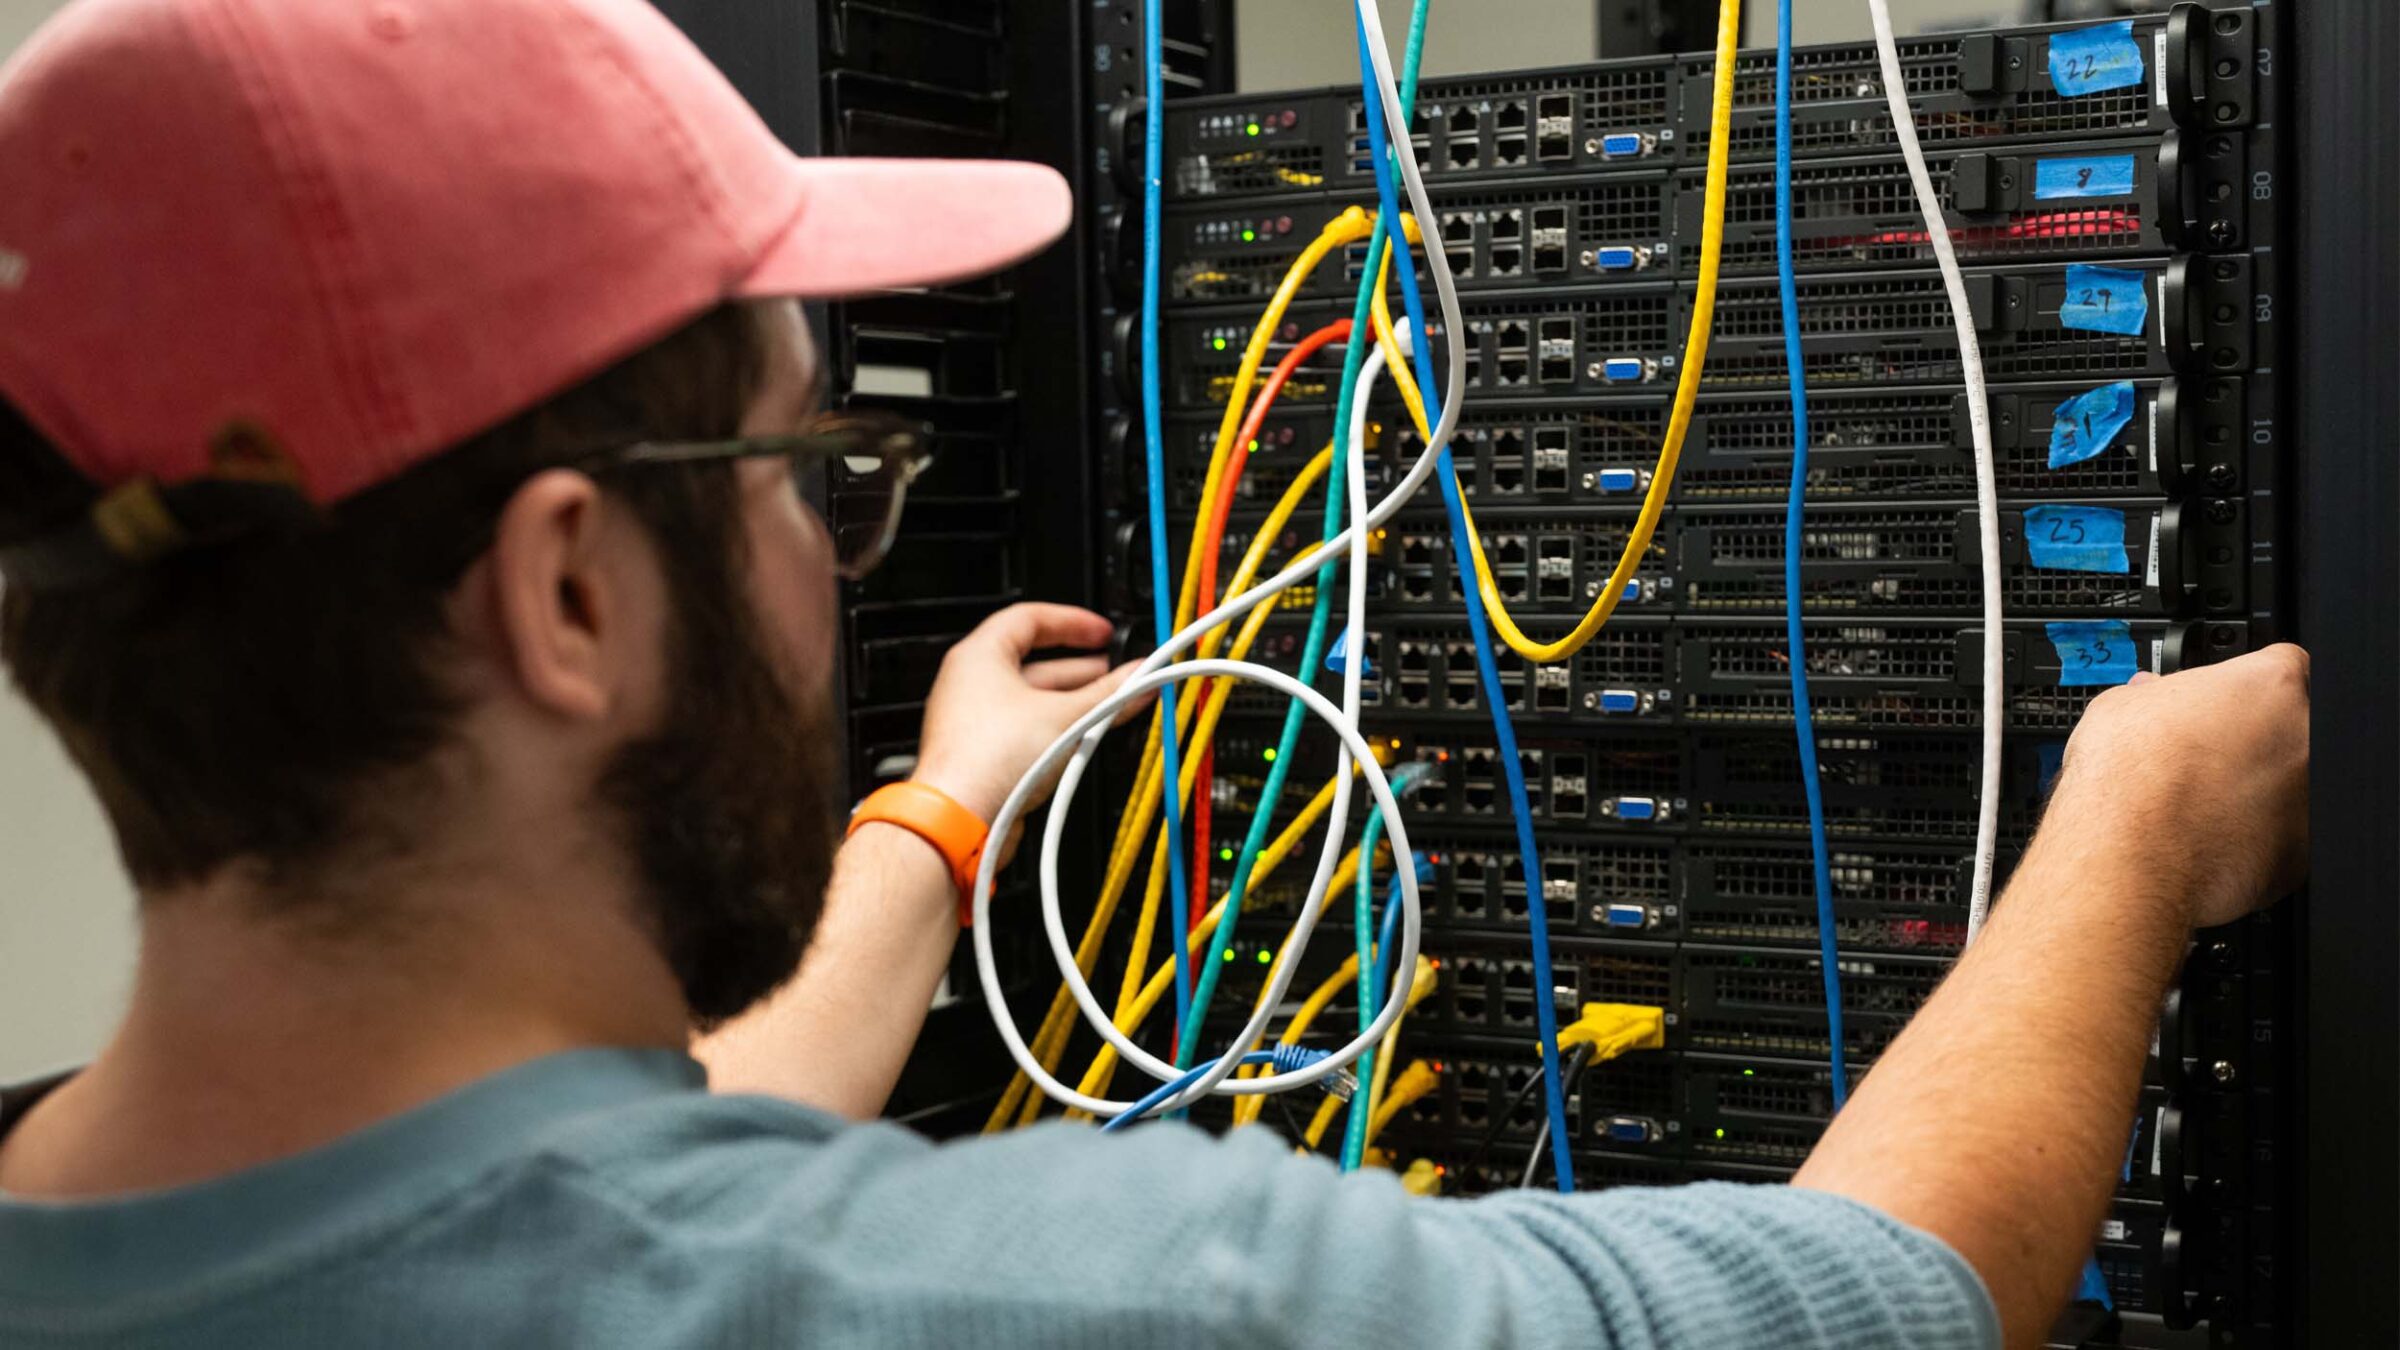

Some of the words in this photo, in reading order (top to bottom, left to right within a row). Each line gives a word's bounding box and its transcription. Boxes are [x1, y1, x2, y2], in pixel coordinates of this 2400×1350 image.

[2067, 54, 2098, 80] 22
[2256, 49, 2272, 76] 07
[2076, 167, 2093, 189] 8
[2253, 171, 2272, 200] 08
[2256, 294, 2272, 323] 09
[2253, 419, 2272, 444] 10
[2049, 516, 2085, 545] 25
[2253, 541, 2272, 563] 11
[2077, 642, 2112, 669] 33
[2254, 1018, 2272, 1043] 15
